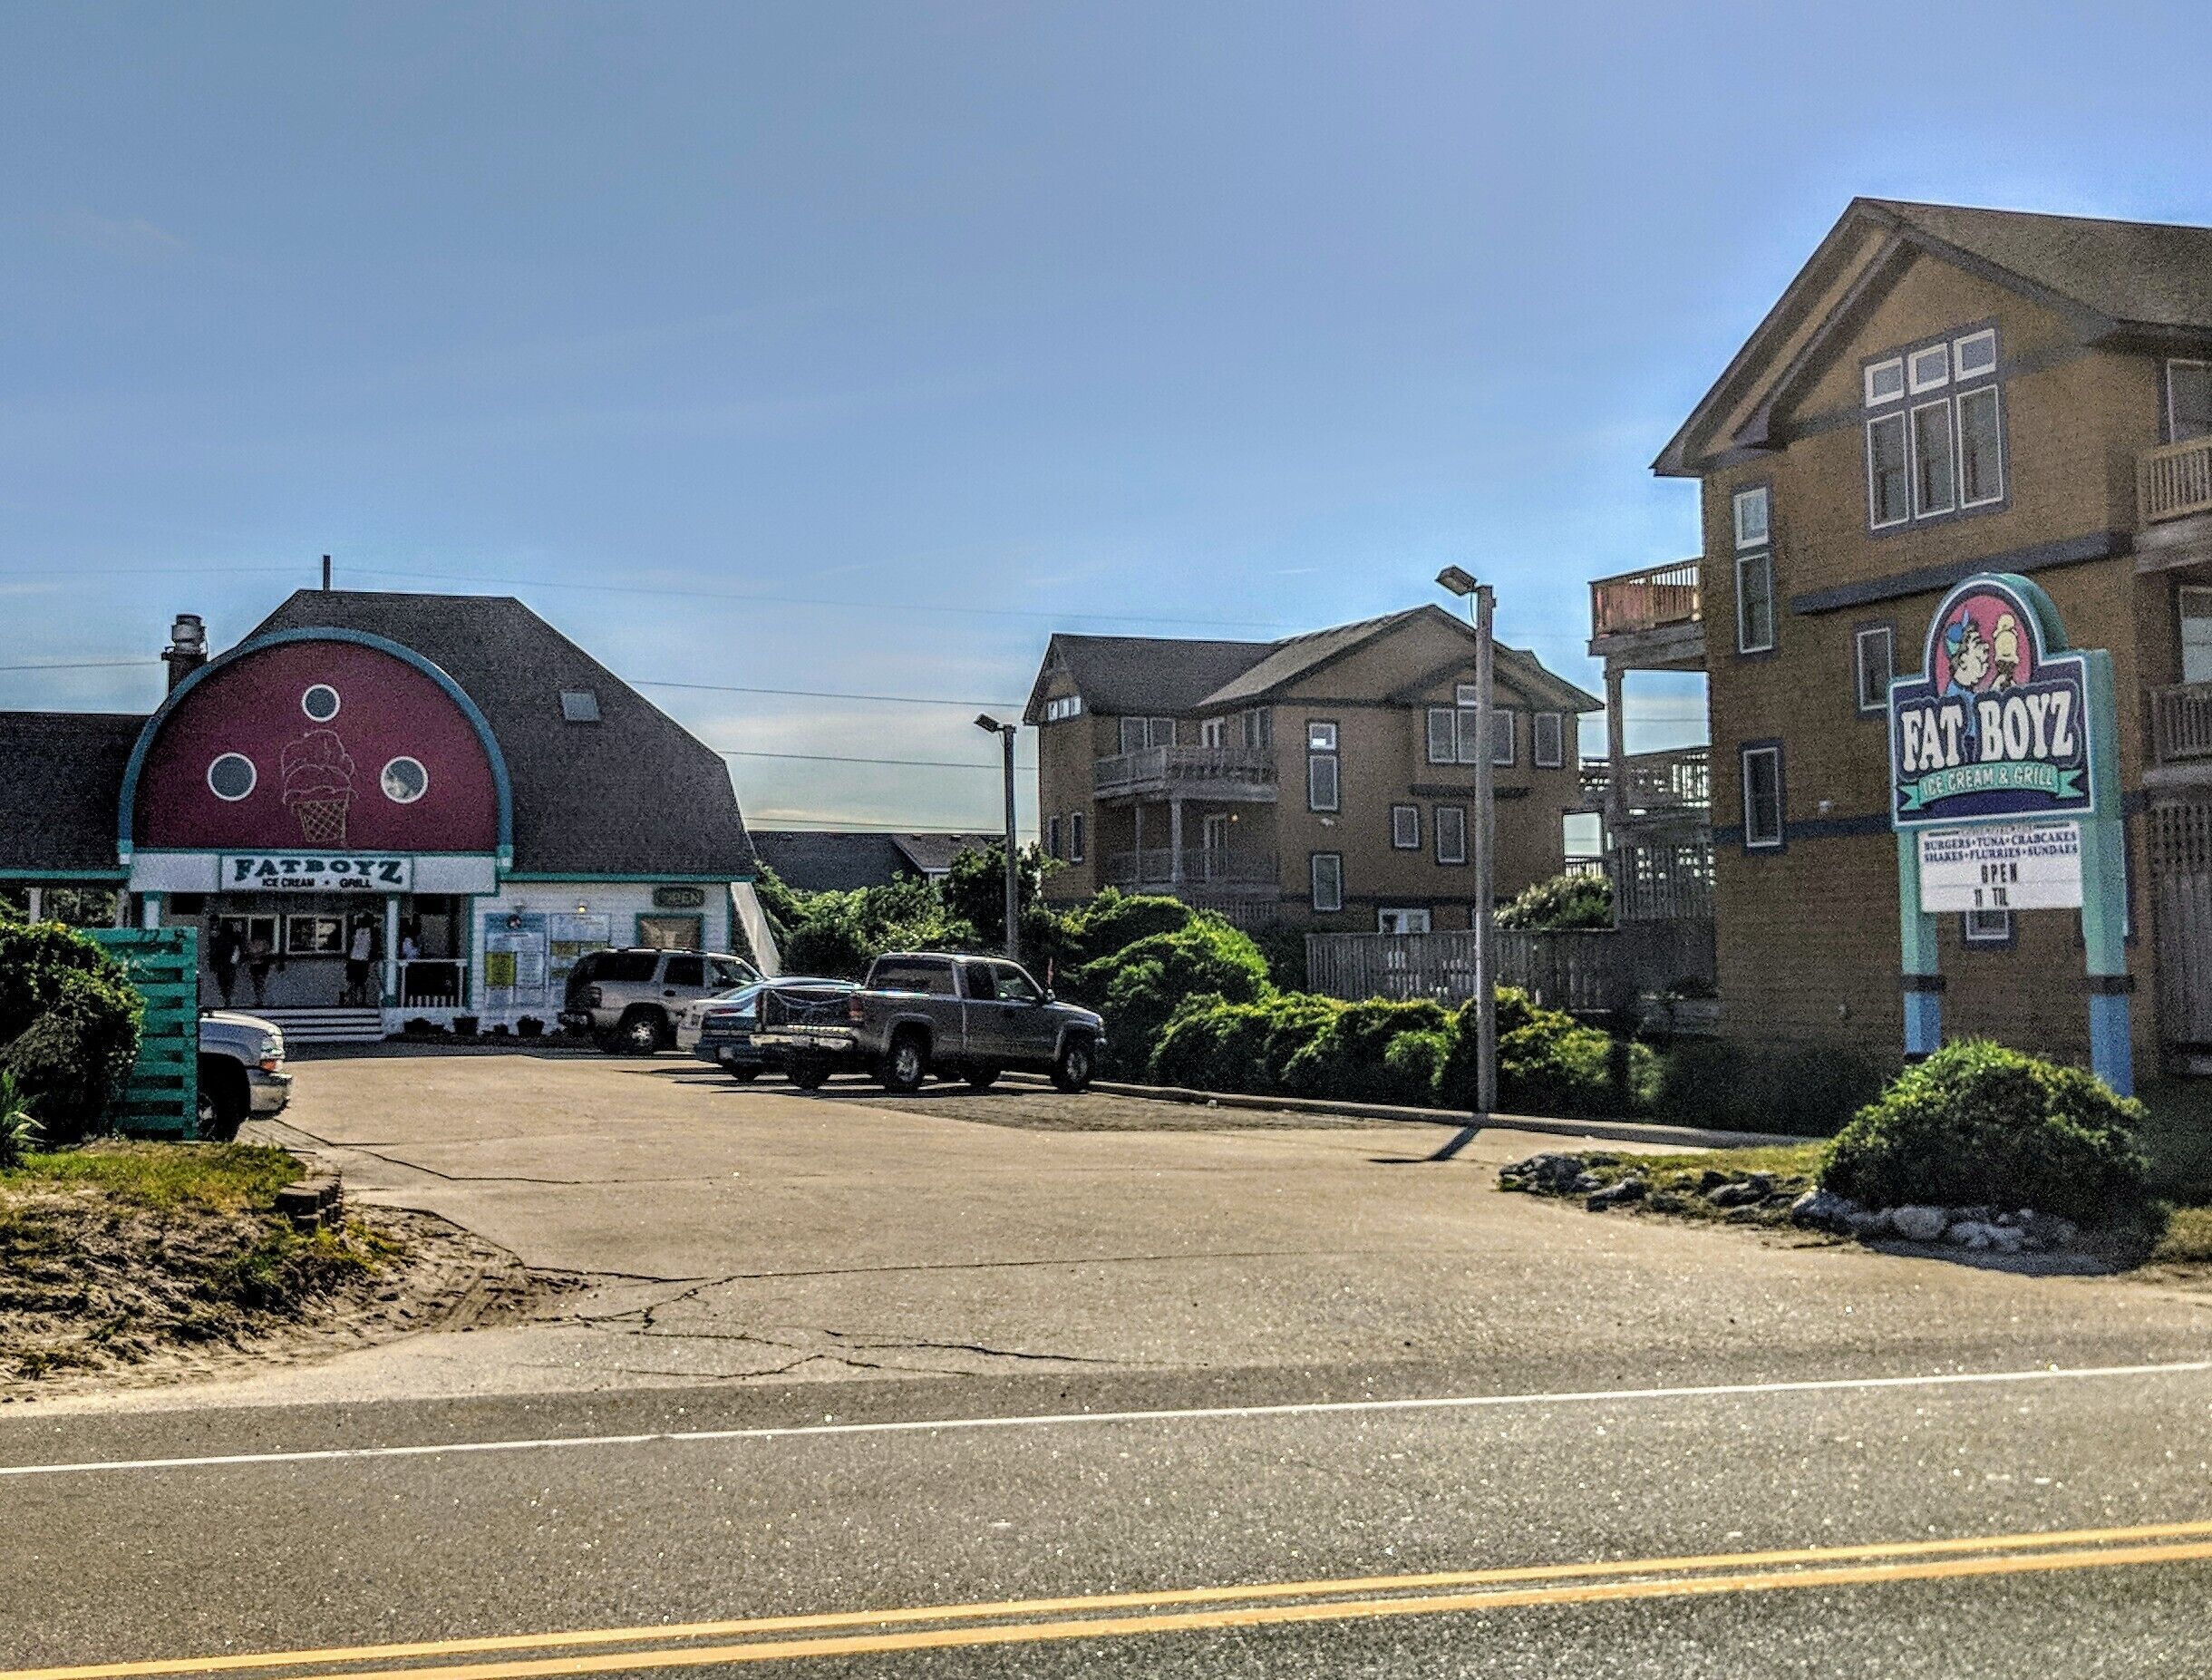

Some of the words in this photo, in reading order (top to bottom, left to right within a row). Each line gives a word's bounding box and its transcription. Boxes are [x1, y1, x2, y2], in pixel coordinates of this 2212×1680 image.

[1901, 704, 1964, 771] FAT
[1977, 690, 2073, 762] BOYZ
[1923, 777, 1945, 796] ICE
[1948, 769, 1994, 791] CREAM
[1998, 768, 2009, 785] &
[2013, 768, 2054, 786] GRILL
[1924, 836, 1971, 850] BURGERS
[1975, 833, 2005, 847] TUNA
[1924, 850, 1964, 862] SHAKES
[1969, 847, 2021, 859] FLURRIES
[2028, 843, 2078, 856] SUNDAES
[234, 858, 403, 885] FATBOYZ
[1981, 862, 2018, 883] OPEN
[262, 878, 277, 888] ICE
[281, 878, 315, 888] CREAM
[339, 878, 373, 889] GRILL
[1992, 887, 2010, 907] TIL
